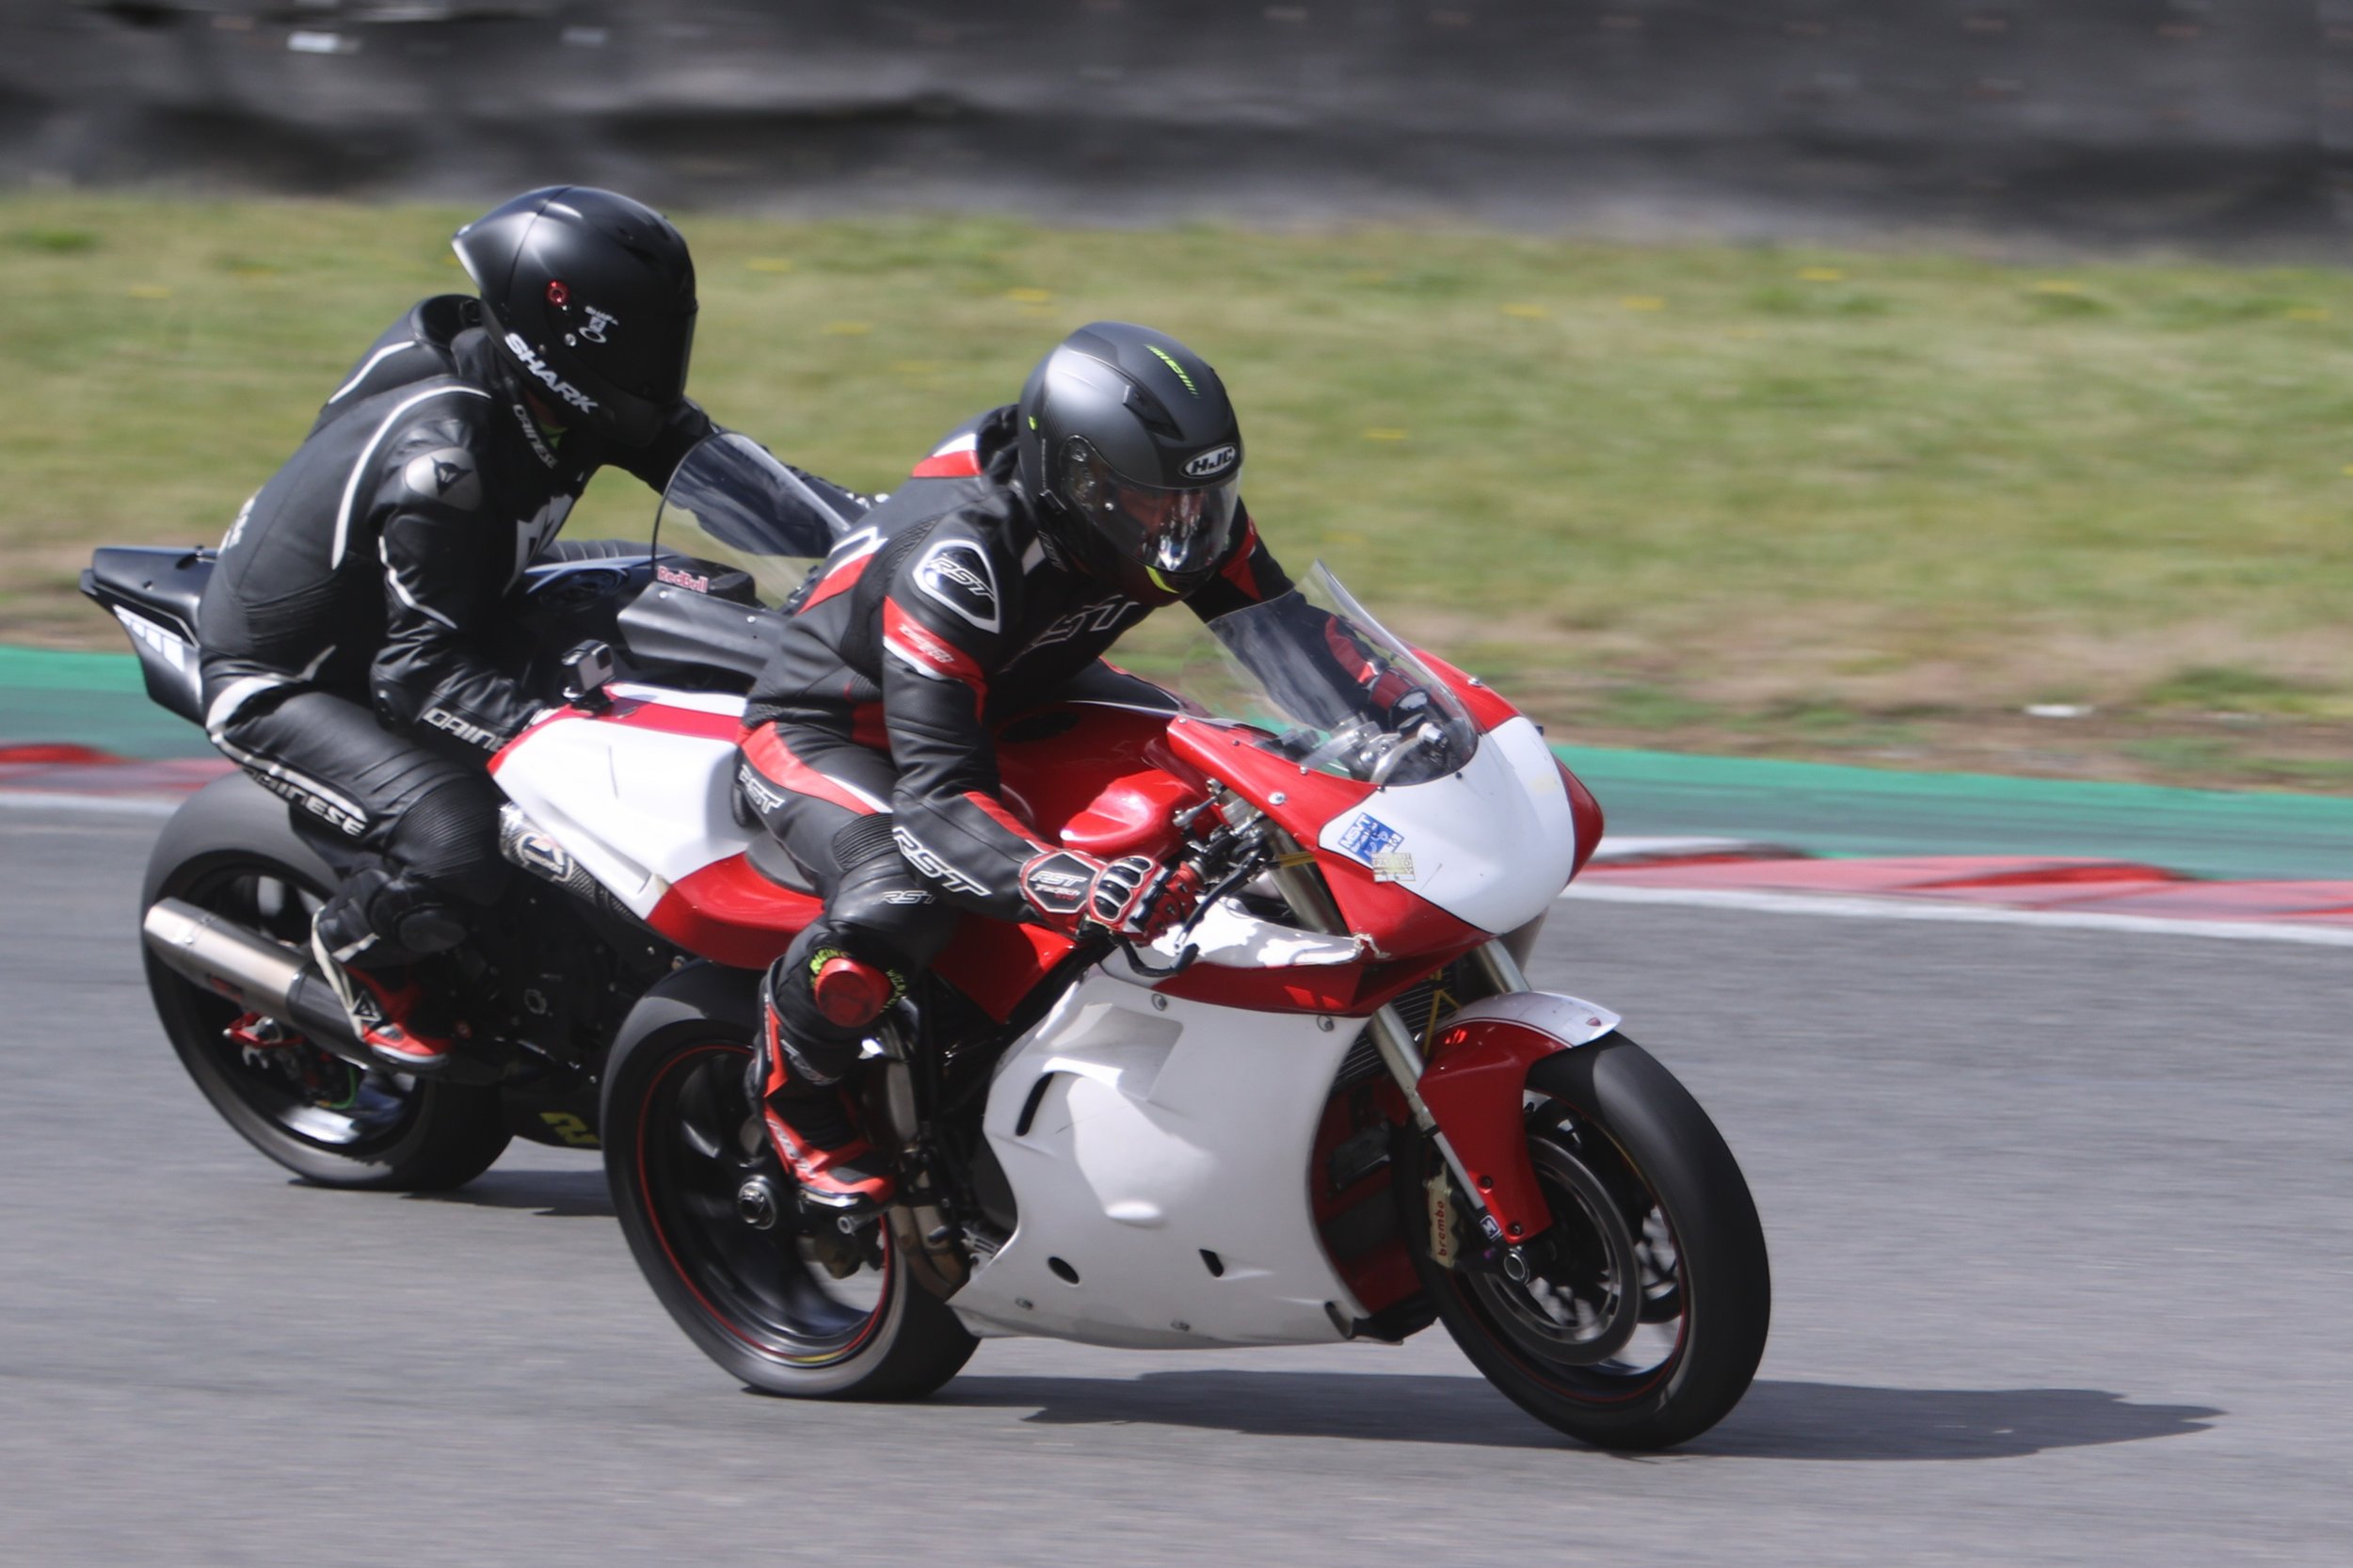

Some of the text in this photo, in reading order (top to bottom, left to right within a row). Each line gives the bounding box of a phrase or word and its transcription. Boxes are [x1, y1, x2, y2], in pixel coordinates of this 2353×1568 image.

[504, 332, 599, 414] SHARK
[1190, 448, 1233, 473] HJC
[738, 764, 786, 815] RST
[892, 826, 993, 897] RST
[1029, 871, 1088, 887] RST
[1434, 1200, 1448, 1257] brembo
